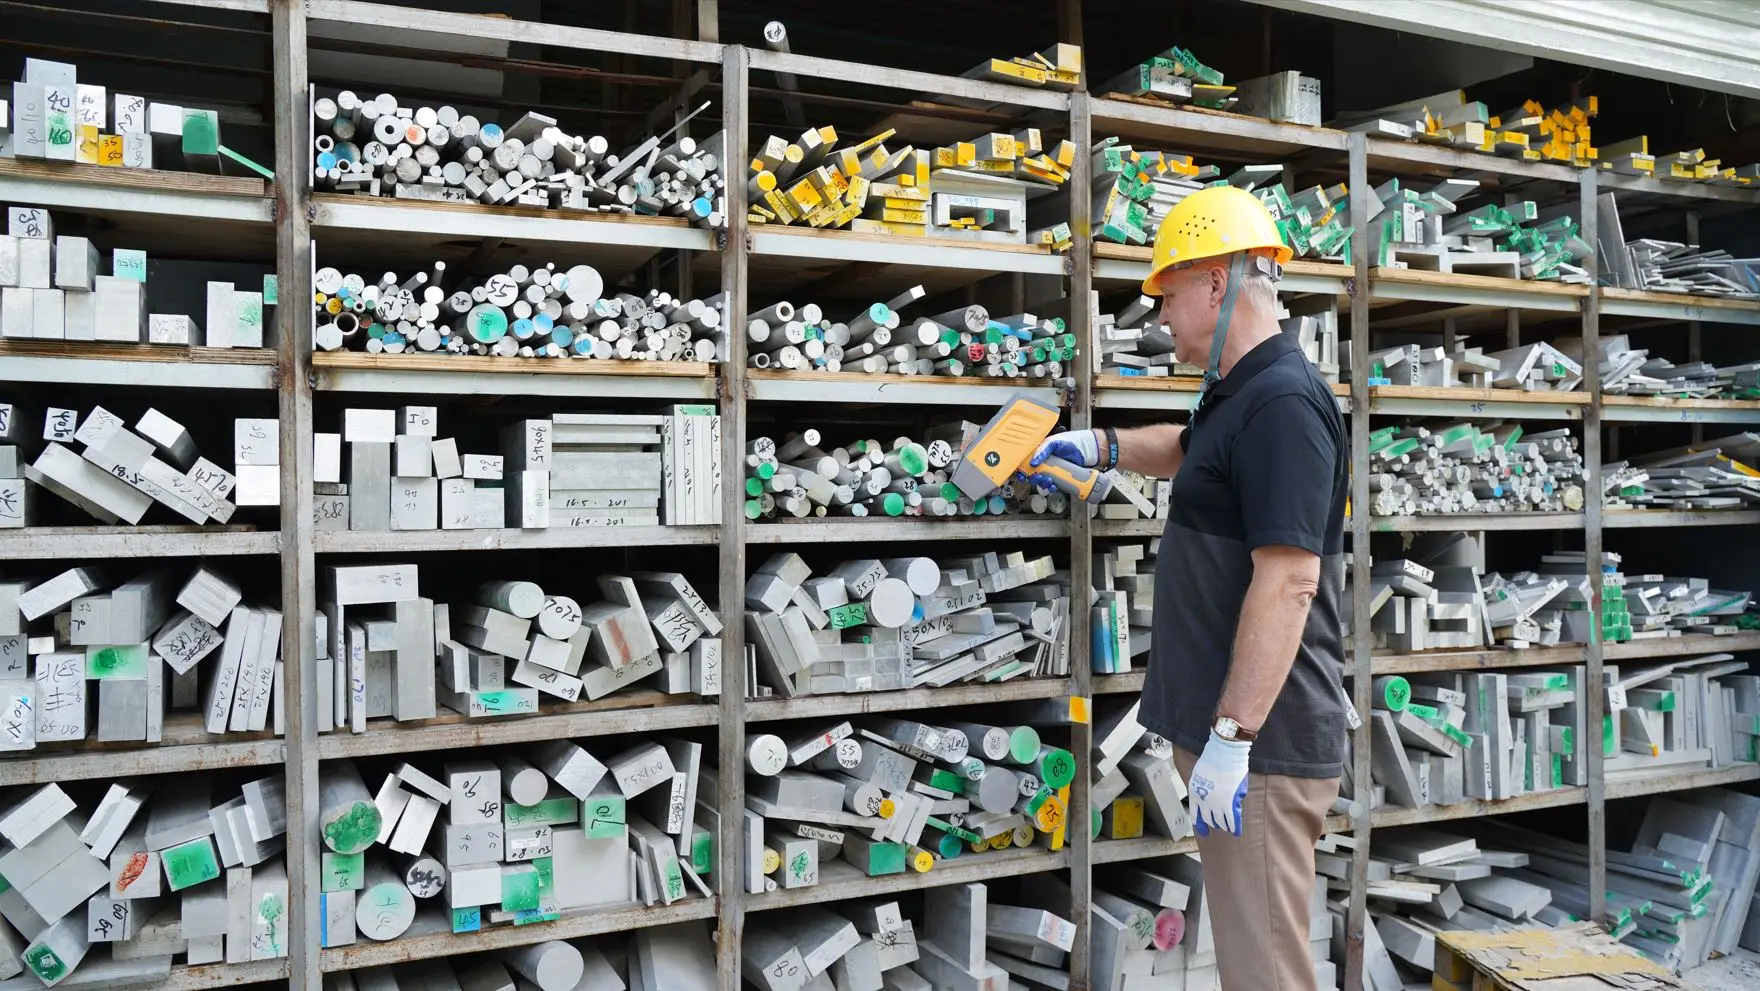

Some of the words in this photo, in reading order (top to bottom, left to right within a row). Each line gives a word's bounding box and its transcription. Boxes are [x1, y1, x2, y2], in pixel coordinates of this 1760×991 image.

[488, 278, 516, 297] 55
[111, 464, 143, 485] 18.5
[608, 499, 627, 507] 201
[544, 599, 581, 623] 7075
[841, 744, 856, 756] 55
[1024, 780, 1039, 792] 42
[458, 911, 478, 929] 45
[773, 960, 798, 977] 80
